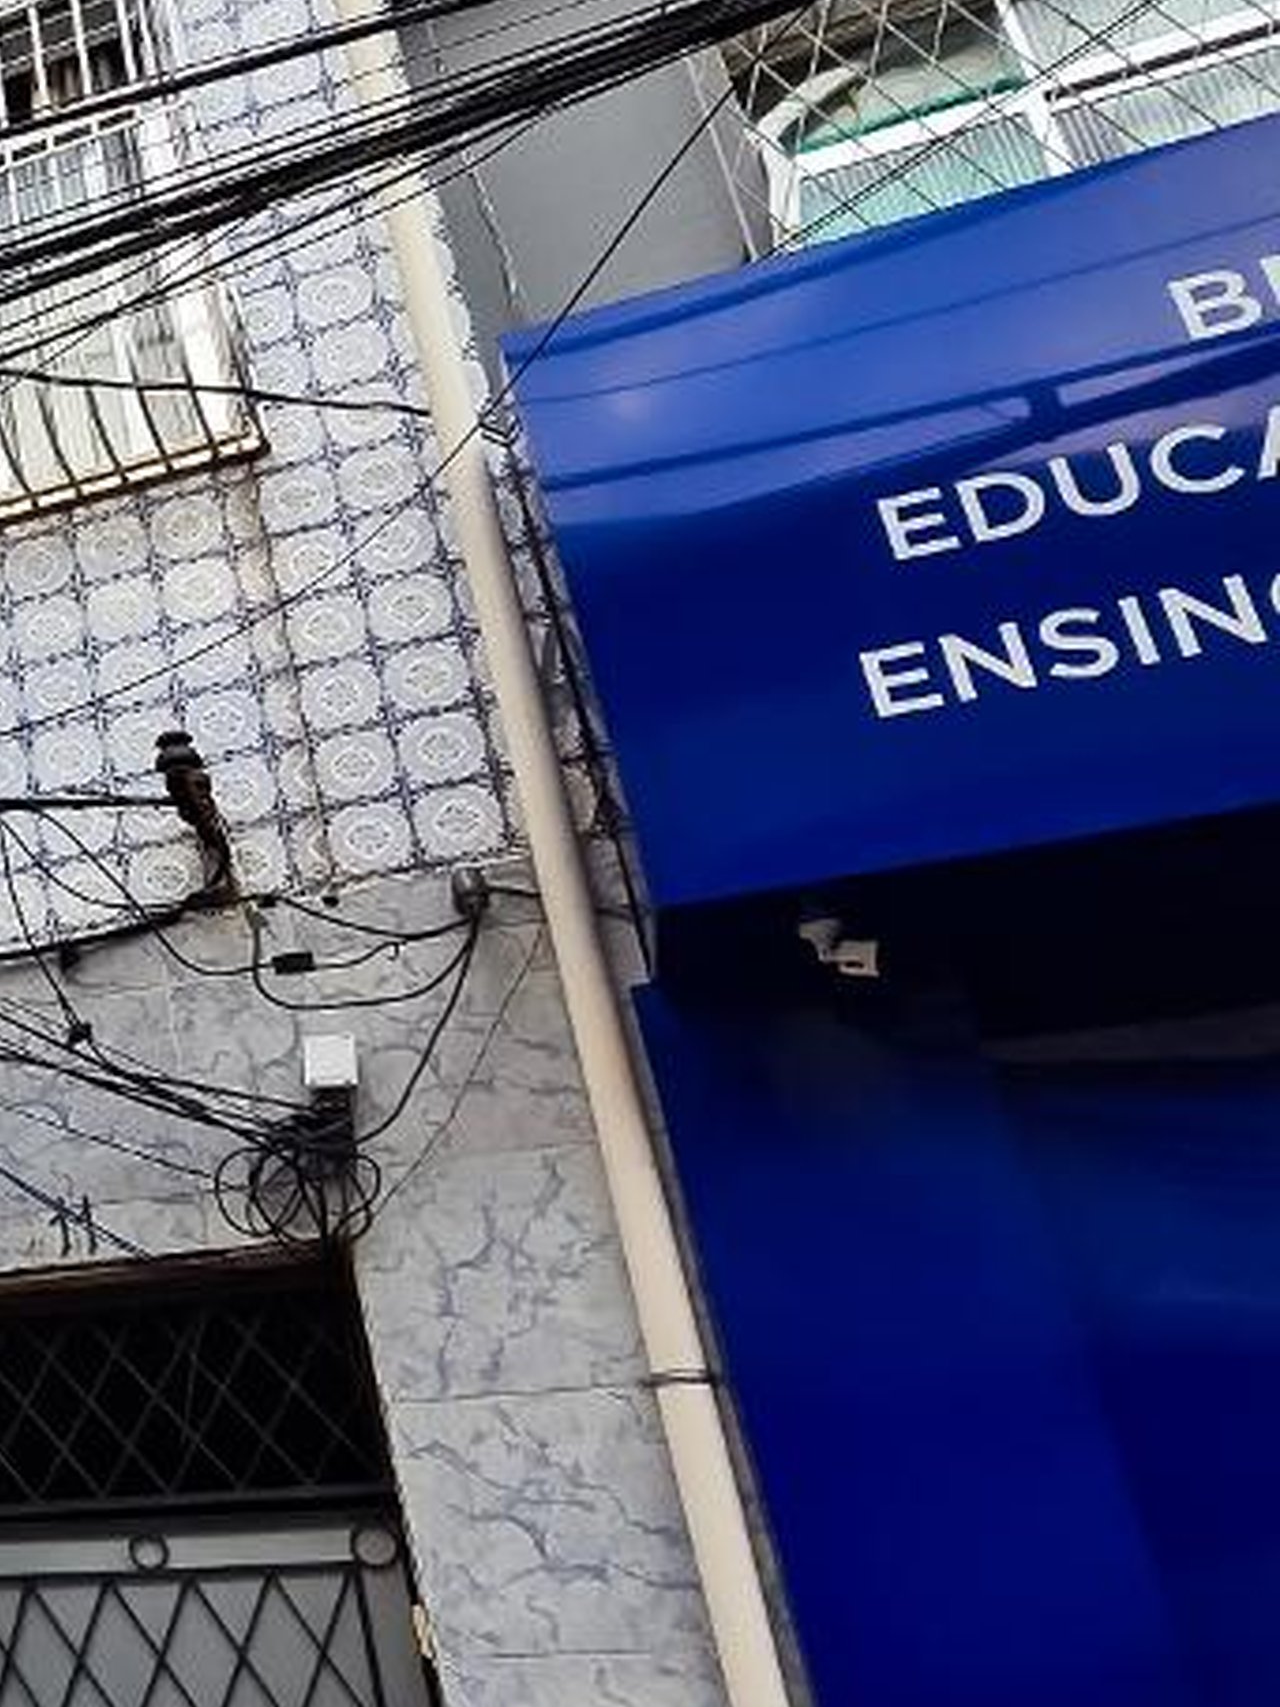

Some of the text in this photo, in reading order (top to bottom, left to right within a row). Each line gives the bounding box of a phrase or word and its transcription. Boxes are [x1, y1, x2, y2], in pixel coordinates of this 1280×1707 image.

[1167, 253, 1280, 340] B
[877, 404, 1280, 562] EDUC
[859, 572, 1280, 719] ENSIN
